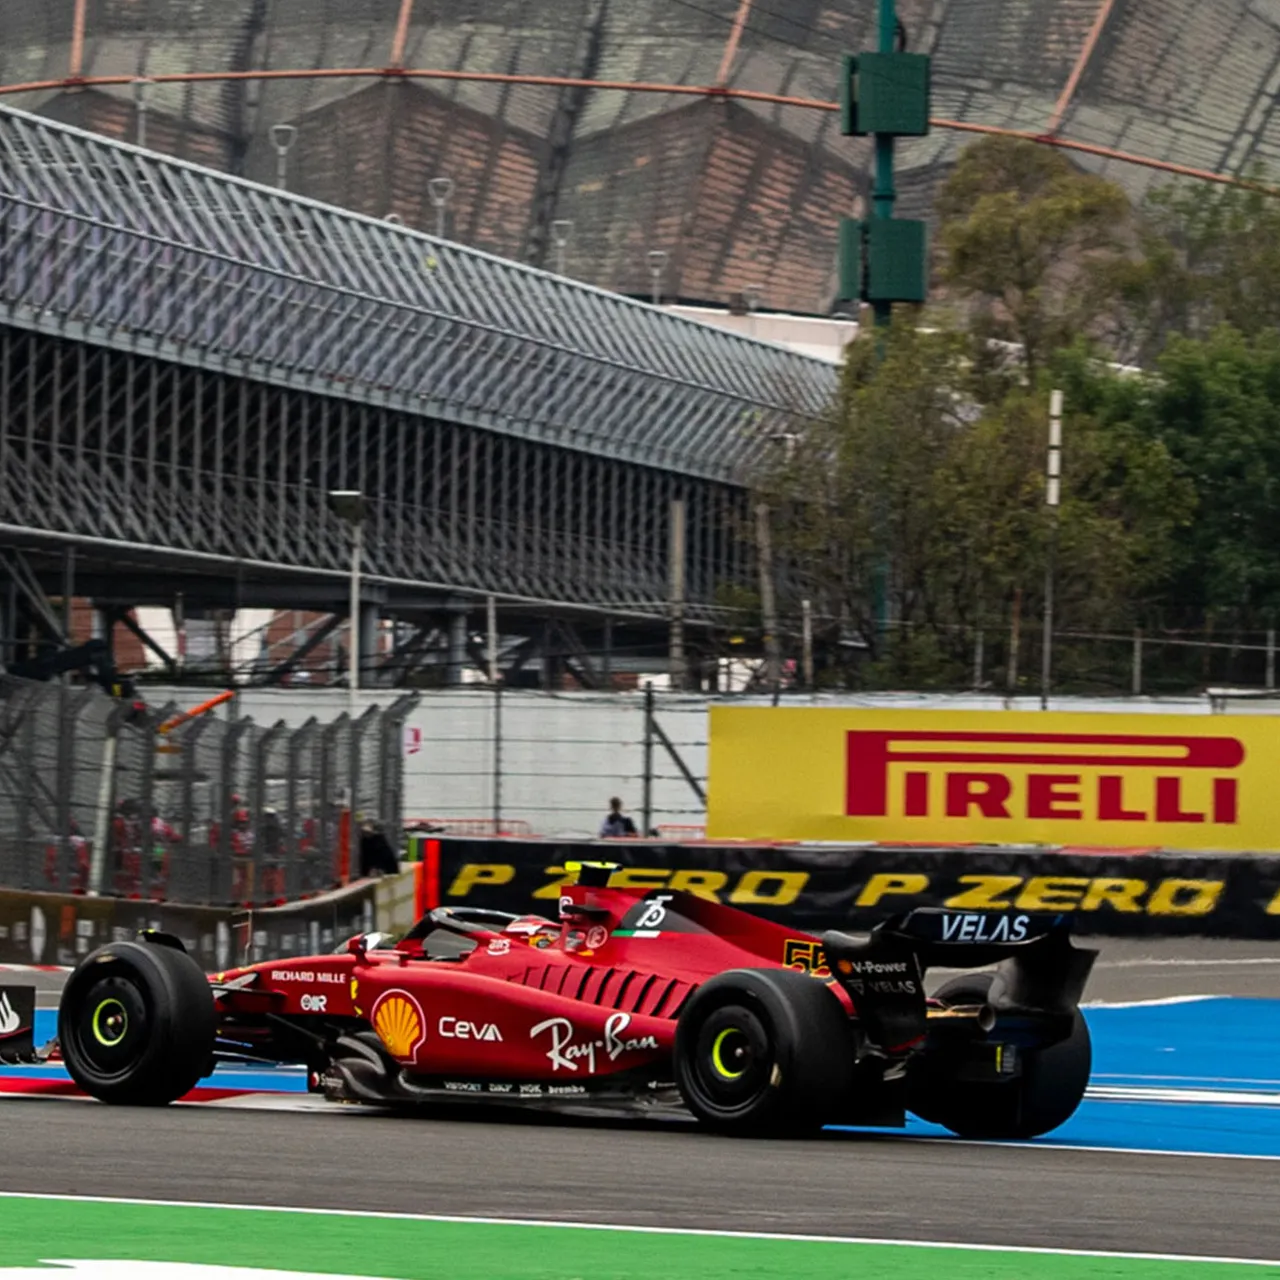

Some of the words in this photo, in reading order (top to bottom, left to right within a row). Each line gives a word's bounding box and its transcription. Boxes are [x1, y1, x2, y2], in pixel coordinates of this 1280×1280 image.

[844, 729, 1246, 825] PIRELLI
[447, 863, 516, 898] P
[854, 873, 930, 908] P
[943, 875, 1226, 918] ZERO
[941, 914, 1032, 942] VELAS
[271, 970, 315, 983] RICHARD
[316, 972, 347, 984] MILLE
[851, 960, 908, 974] V-Power
[868, 980, 916, 995] VELAS
